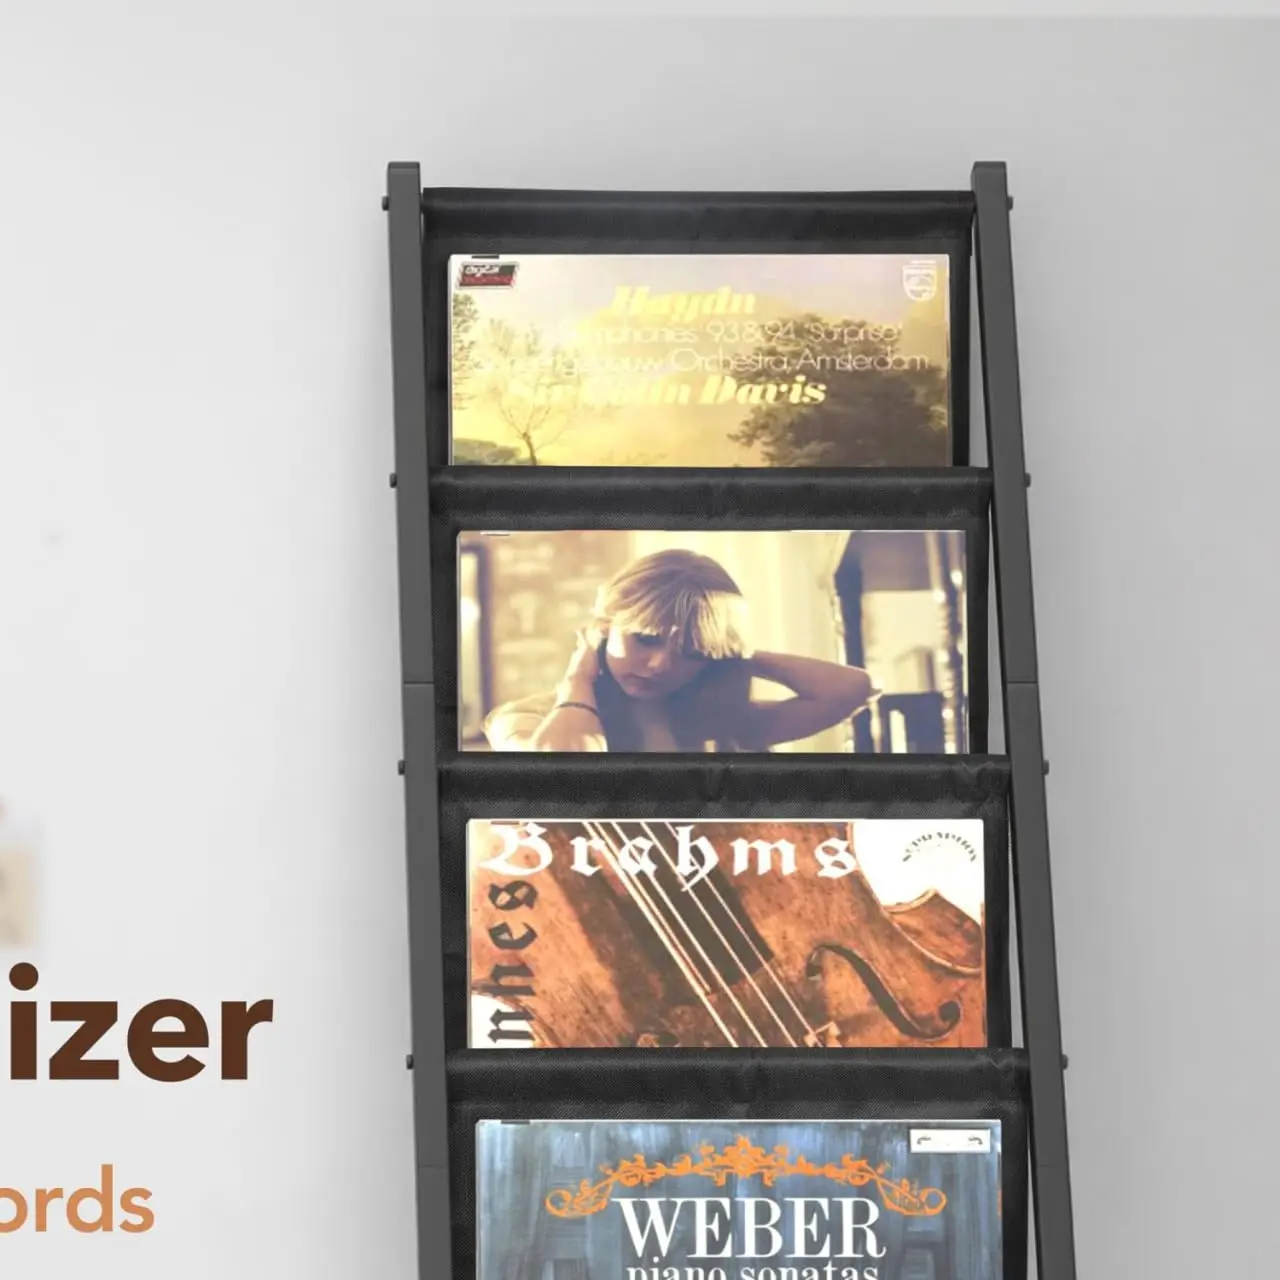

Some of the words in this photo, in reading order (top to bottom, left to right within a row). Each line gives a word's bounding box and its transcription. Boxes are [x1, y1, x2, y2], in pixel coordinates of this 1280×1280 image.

[610, 285, 757, 321] Haydn
[795, 345, 929, 373] Amsterdam
[697, 373, 828, 406] Davis
[478, 822, 859, 892] Brahms
[611, 1196, 887, 1259] WEBER
